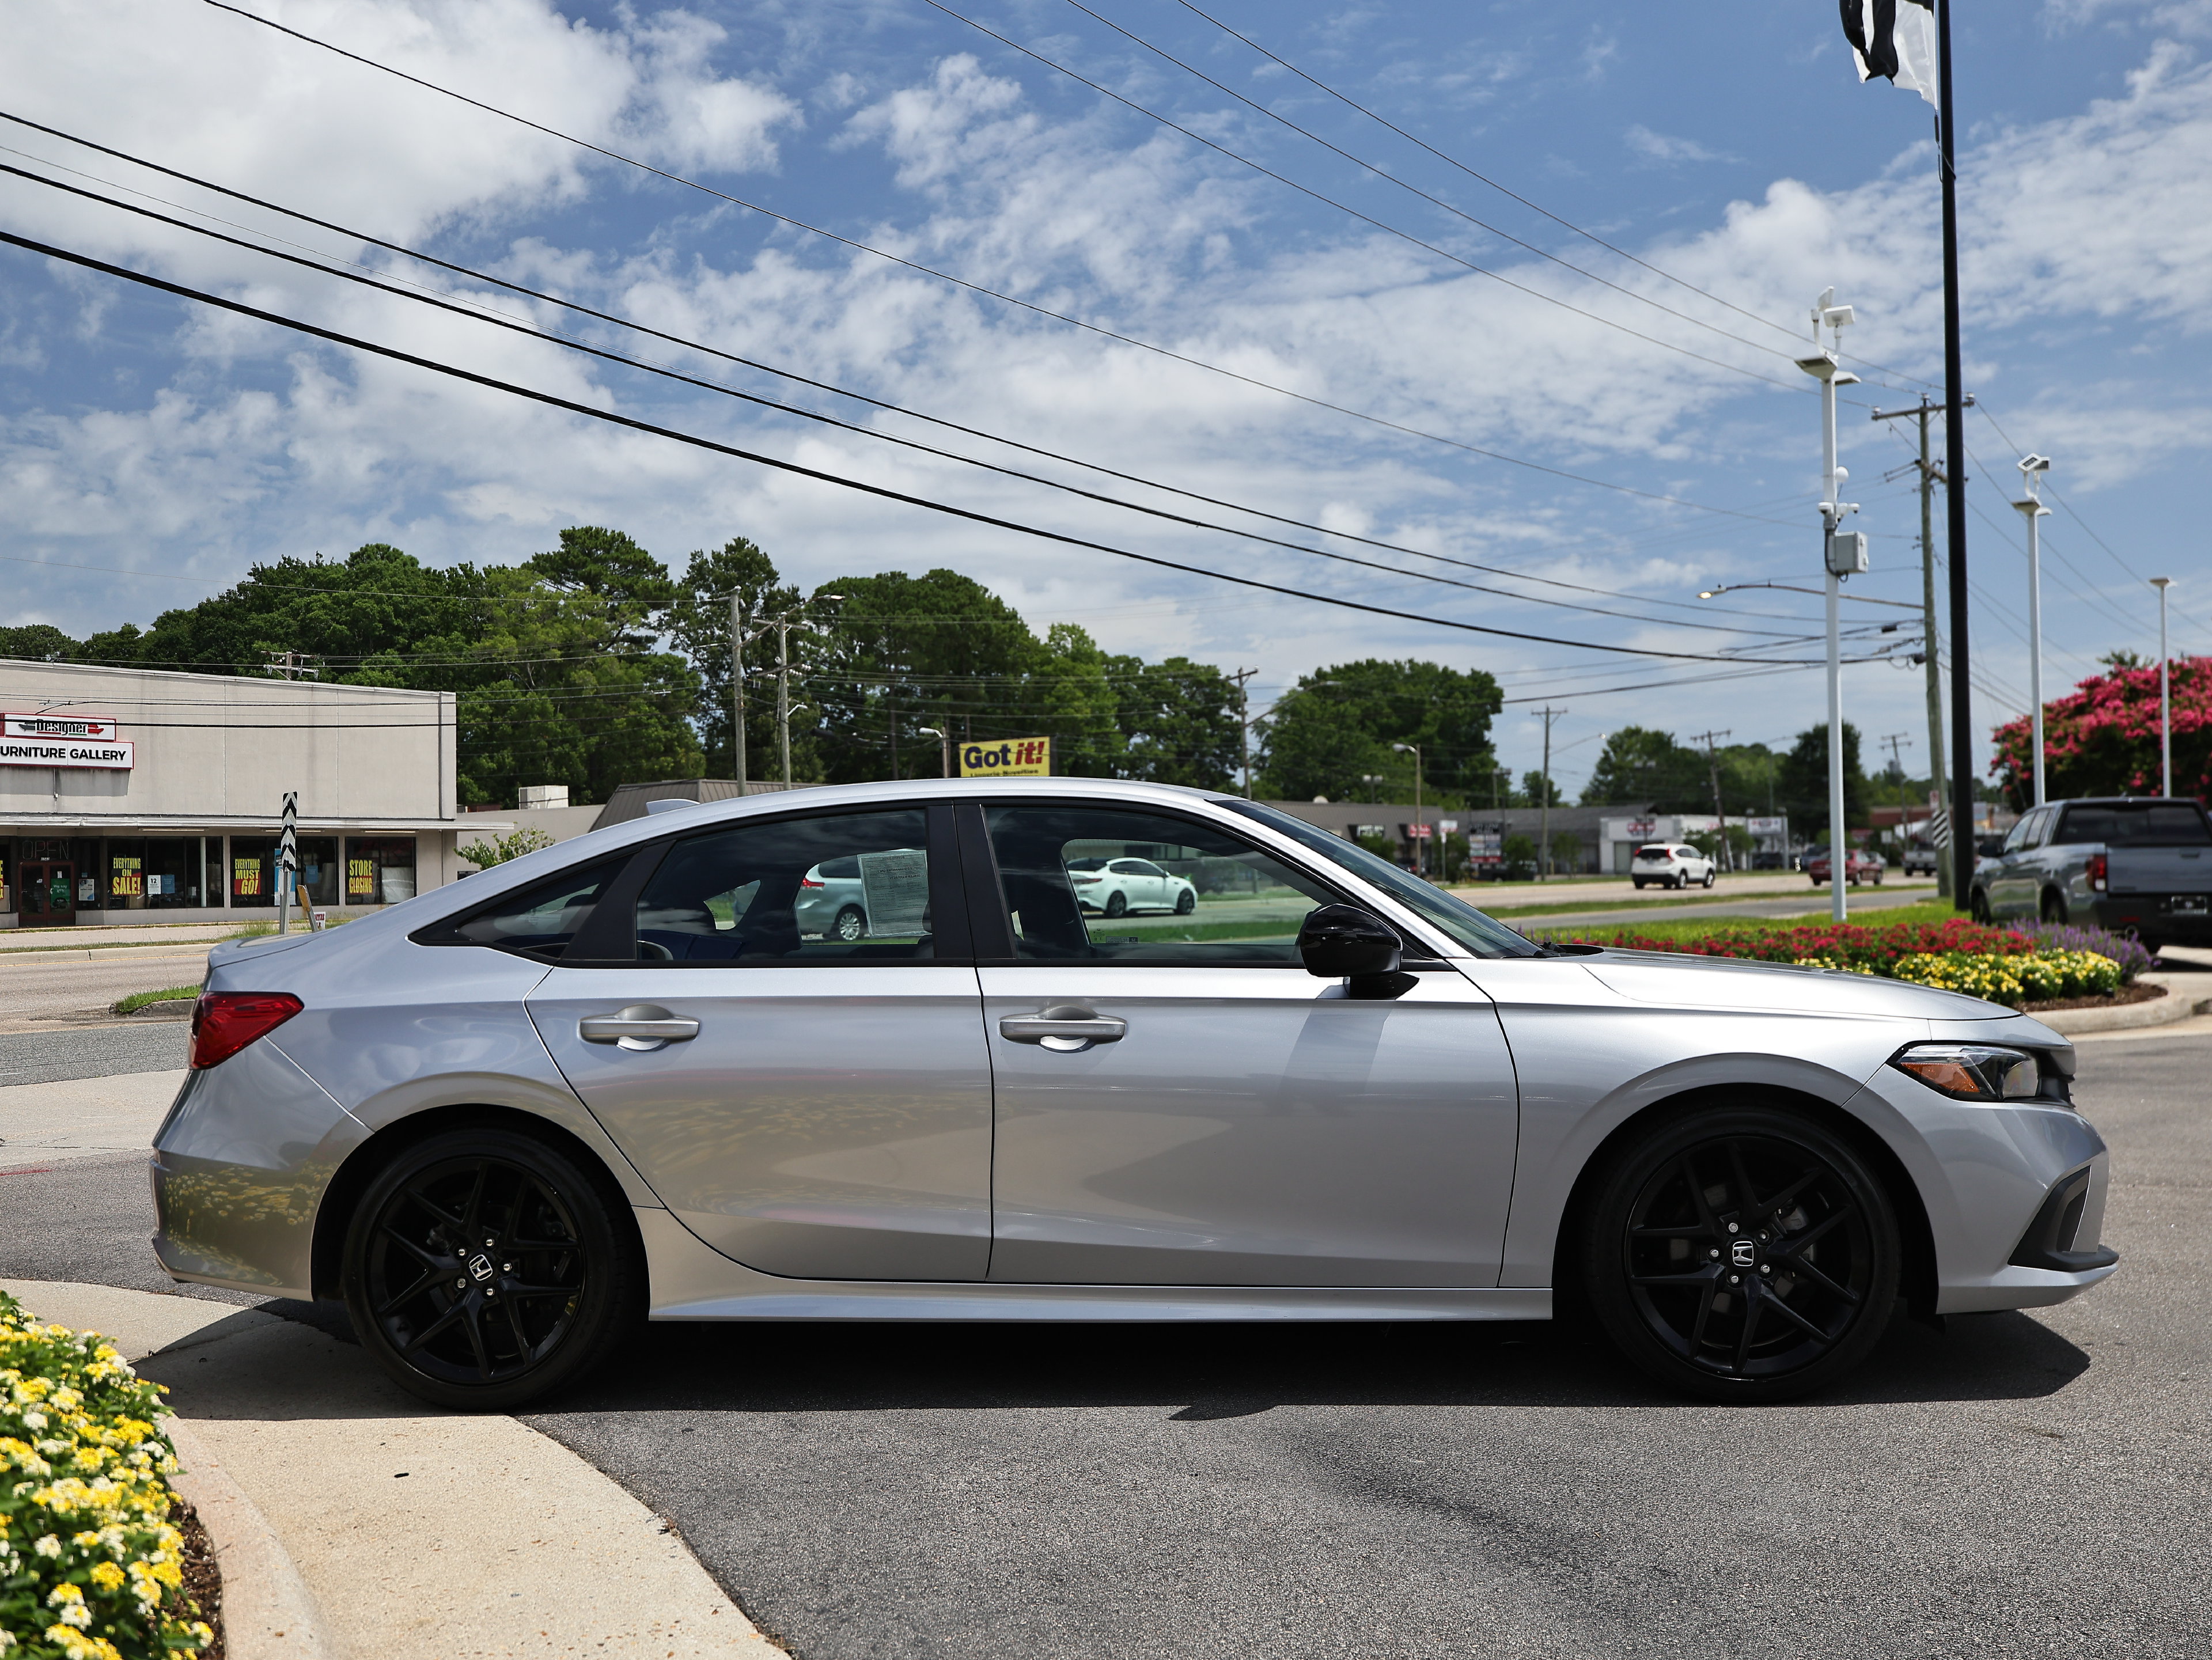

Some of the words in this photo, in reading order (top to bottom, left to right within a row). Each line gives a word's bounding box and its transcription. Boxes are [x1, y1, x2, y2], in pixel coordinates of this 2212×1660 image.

[36, 719, 87, 735] Designer
[0, 746, 66, 759] URNITURE
[70, 748, 126, 761] GALLERY
[964, 744, 1011, 769] Got
[1015, 741, 1045, 765] it!
[22, 840, 69, 860] OPEN
[113, 858, 141, 869] EVERYTHING
[235, 859, 260, 870] EVERYTHING
[349, 859, 372, 876] STORE
[122, 869, 131, 877] ON
[235, 869, 260, 880] MUST
[113, 876, 141, 895] SALE!
[241, 880, 259, 895] GO!
[349, 877, 373, 893] CLOSING
